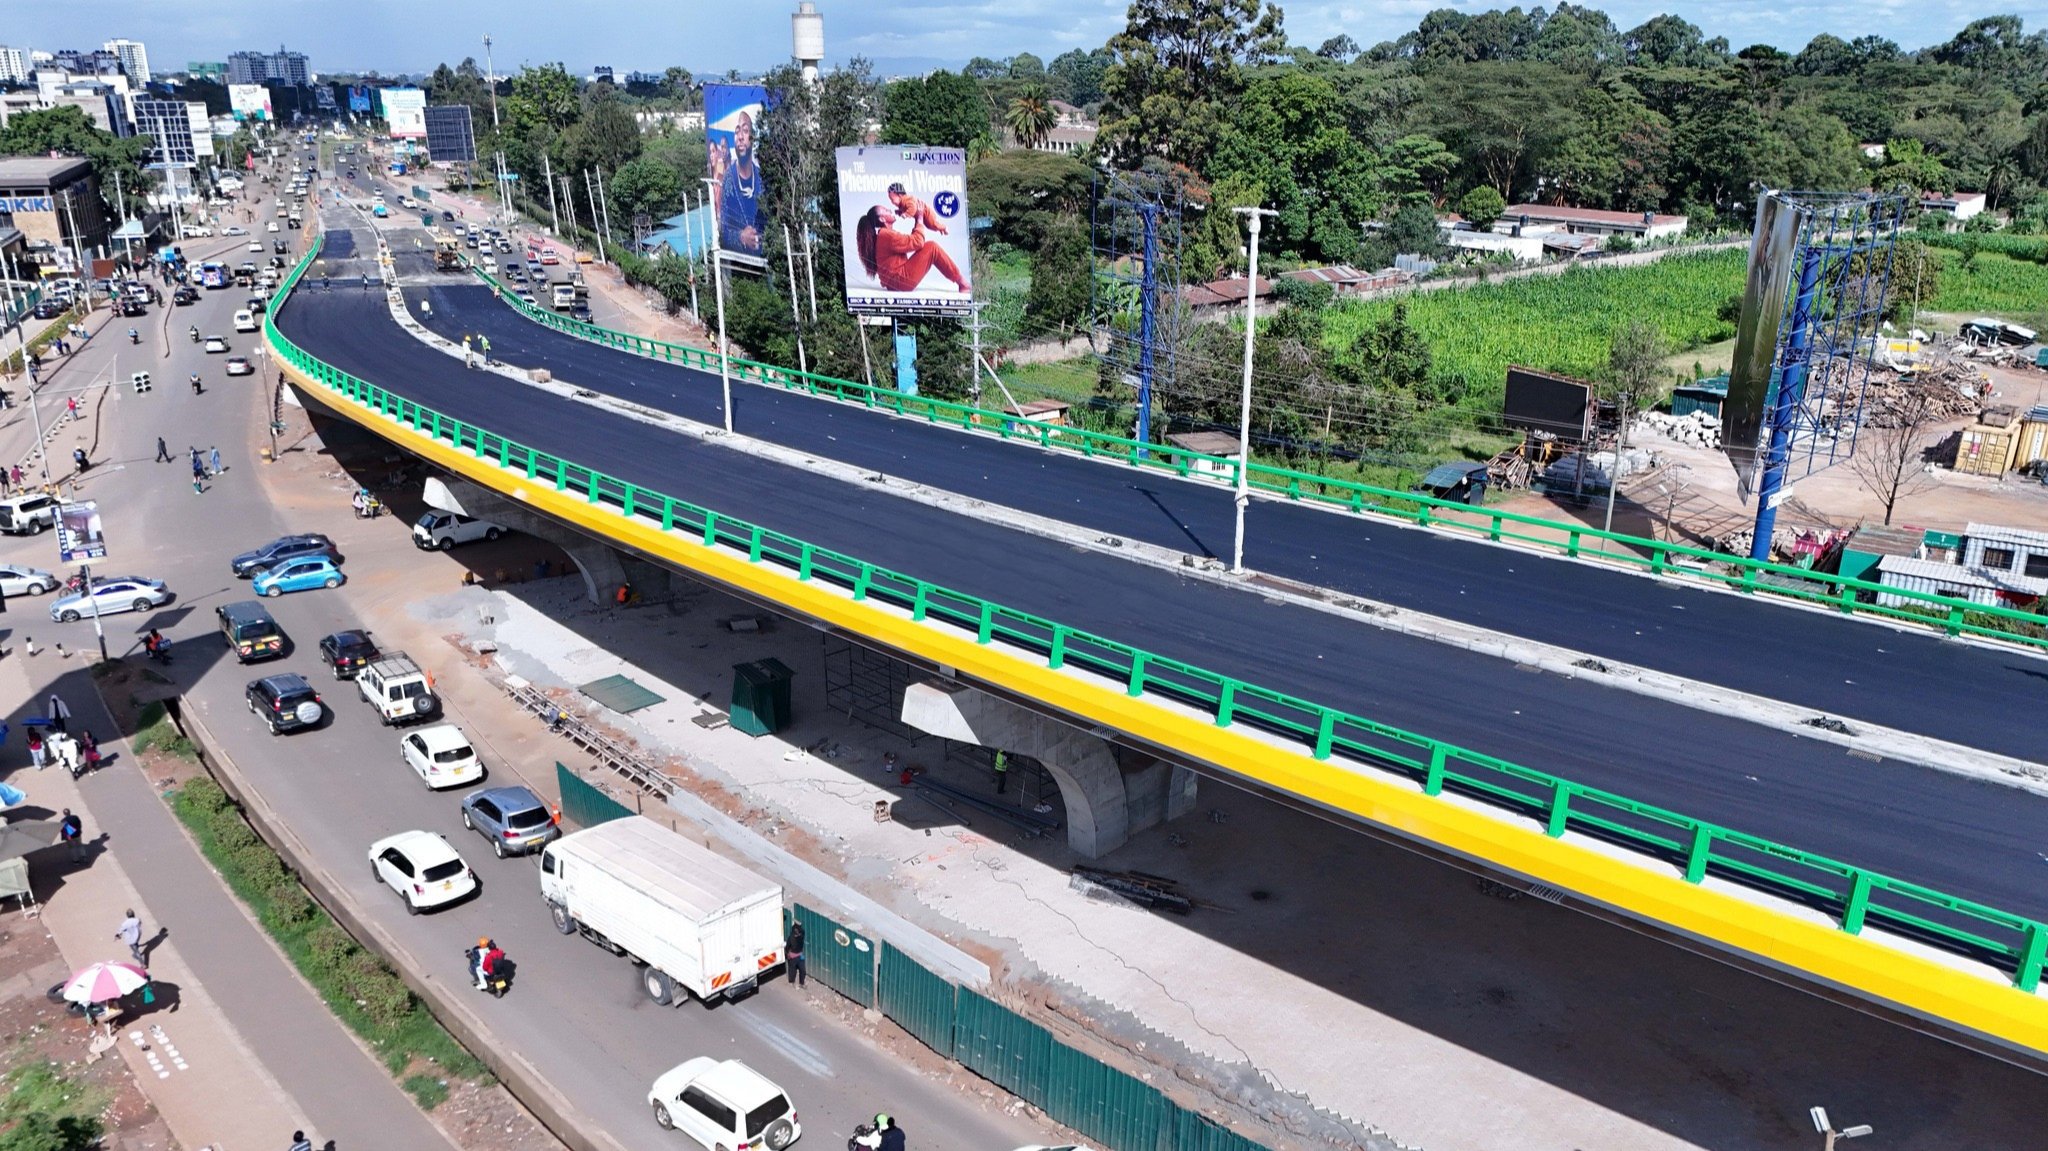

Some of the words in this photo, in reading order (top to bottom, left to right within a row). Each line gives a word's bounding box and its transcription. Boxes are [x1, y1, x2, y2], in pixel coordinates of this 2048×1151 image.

[912, 152, 960, 161] JUNCTION
[853, 161, 865, 173] THE
[840, 168, 913, 193] Phenomenal
[914, 169, 963, 193] Woman
